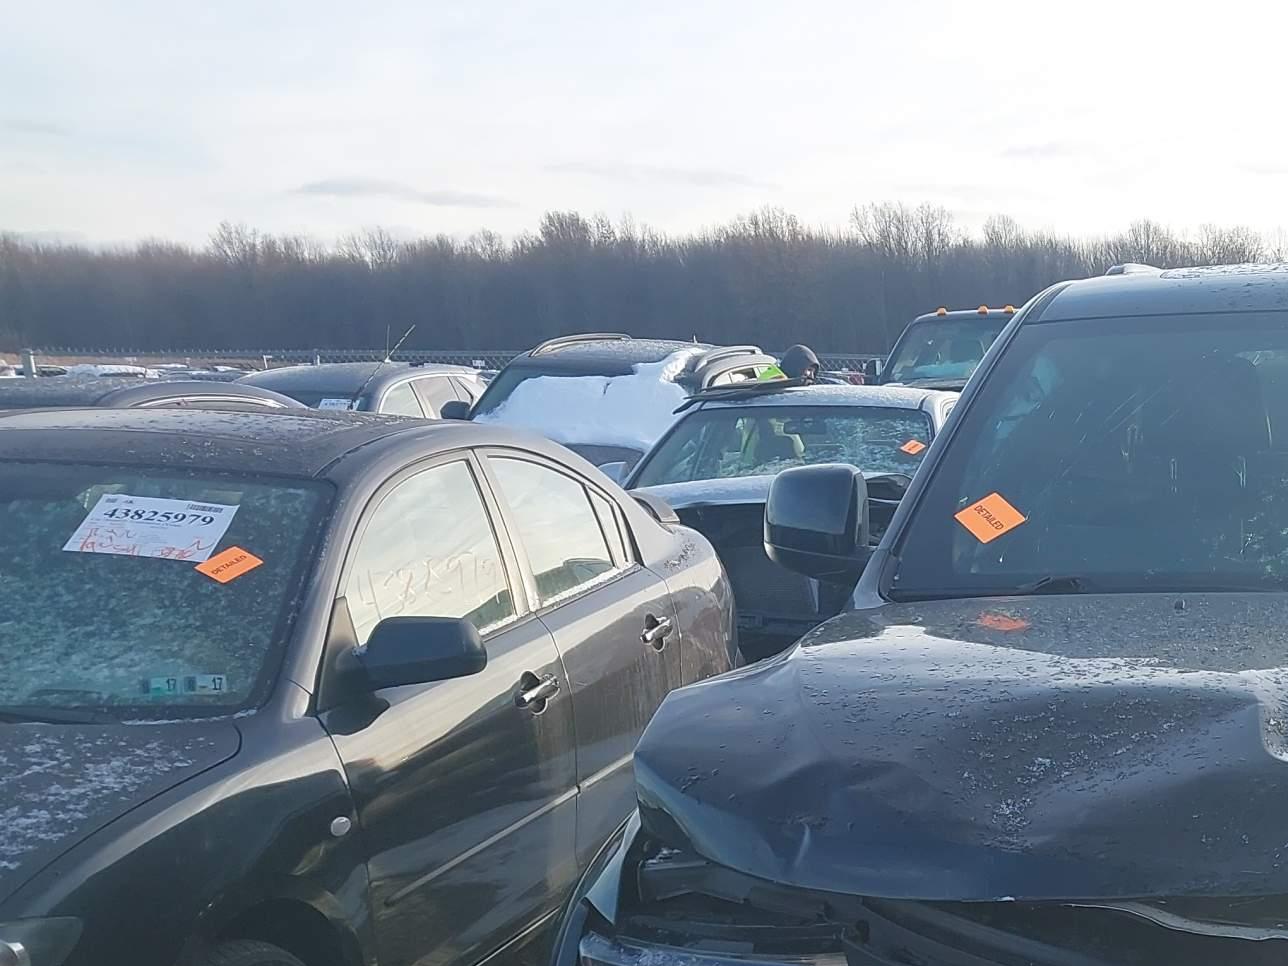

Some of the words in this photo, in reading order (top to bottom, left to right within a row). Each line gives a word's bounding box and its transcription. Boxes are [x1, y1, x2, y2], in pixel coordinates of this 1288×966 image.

[103, 507, 216, 527] 43825979
[973, 504, 1005, 531] DETAILED
[210, 554, 248, 576] DETAILED
[211, 676, 224, 691] 17
